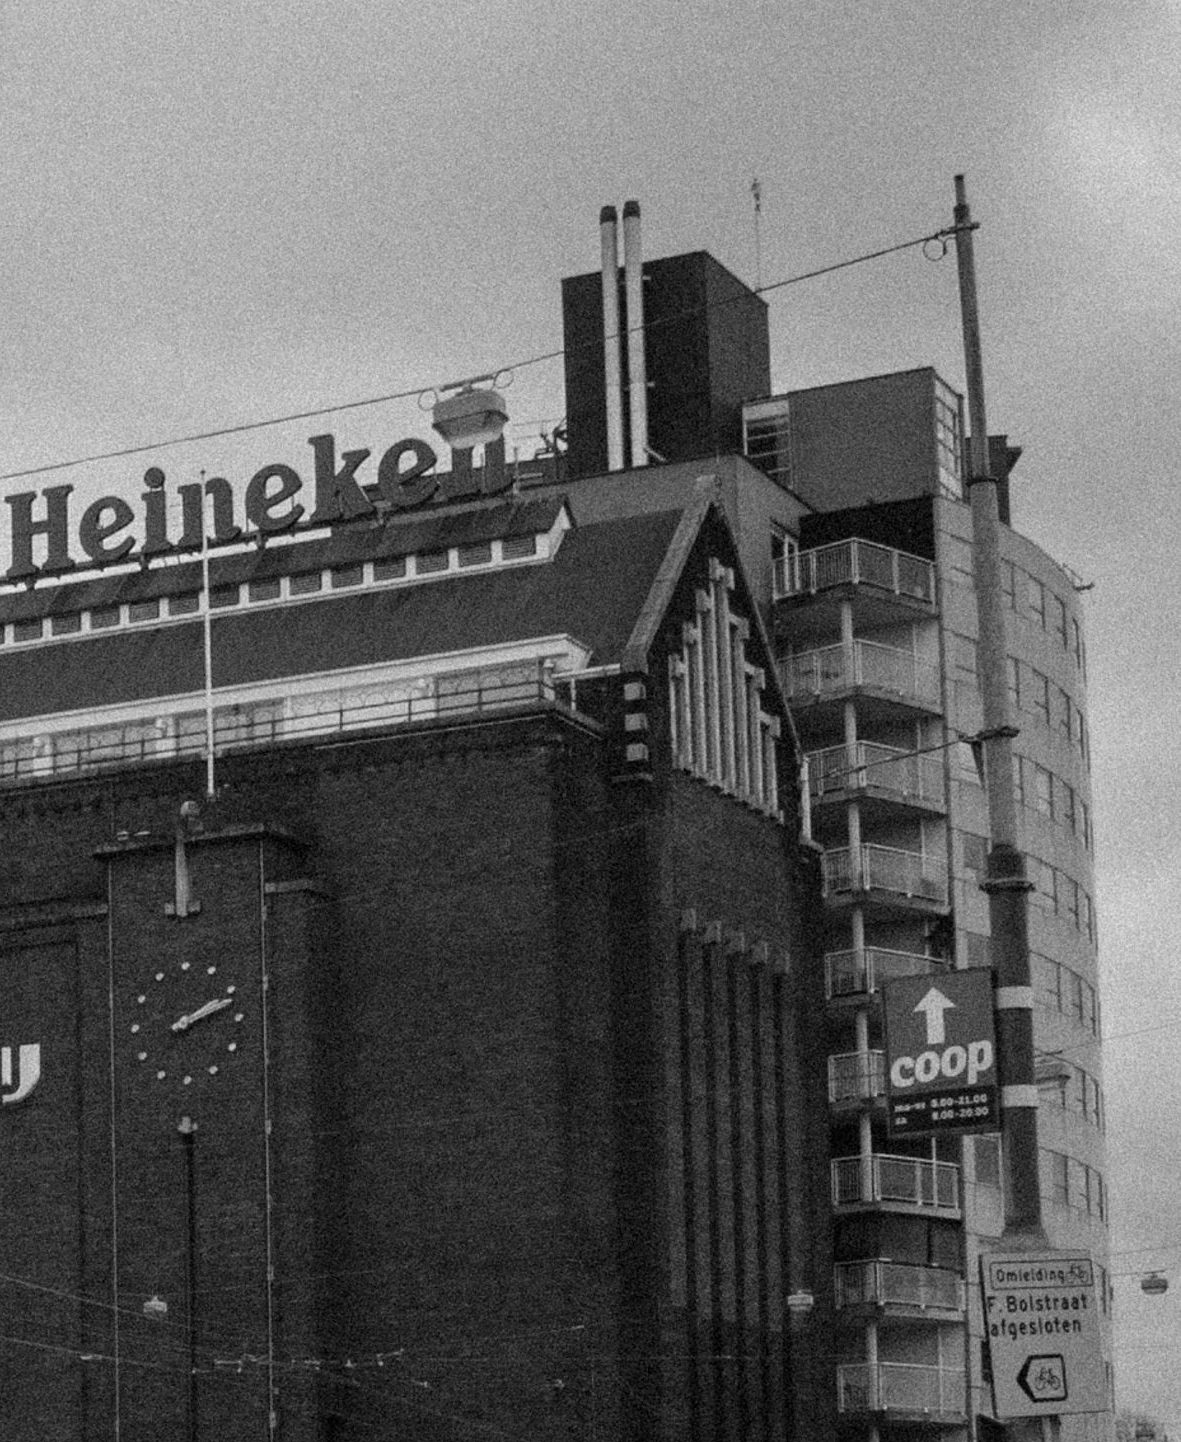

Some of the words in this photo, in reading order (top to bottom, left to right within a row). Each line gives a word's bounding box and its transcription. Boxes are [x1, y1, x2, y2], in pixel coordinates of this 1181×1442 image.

[4, 433, 516, 577] Heineken
[890, 1039, 994, 1088] coop
[995, 1267, 1065, 1285] Omleiding
[990, 1318, 1082, 1341] afgesloten
